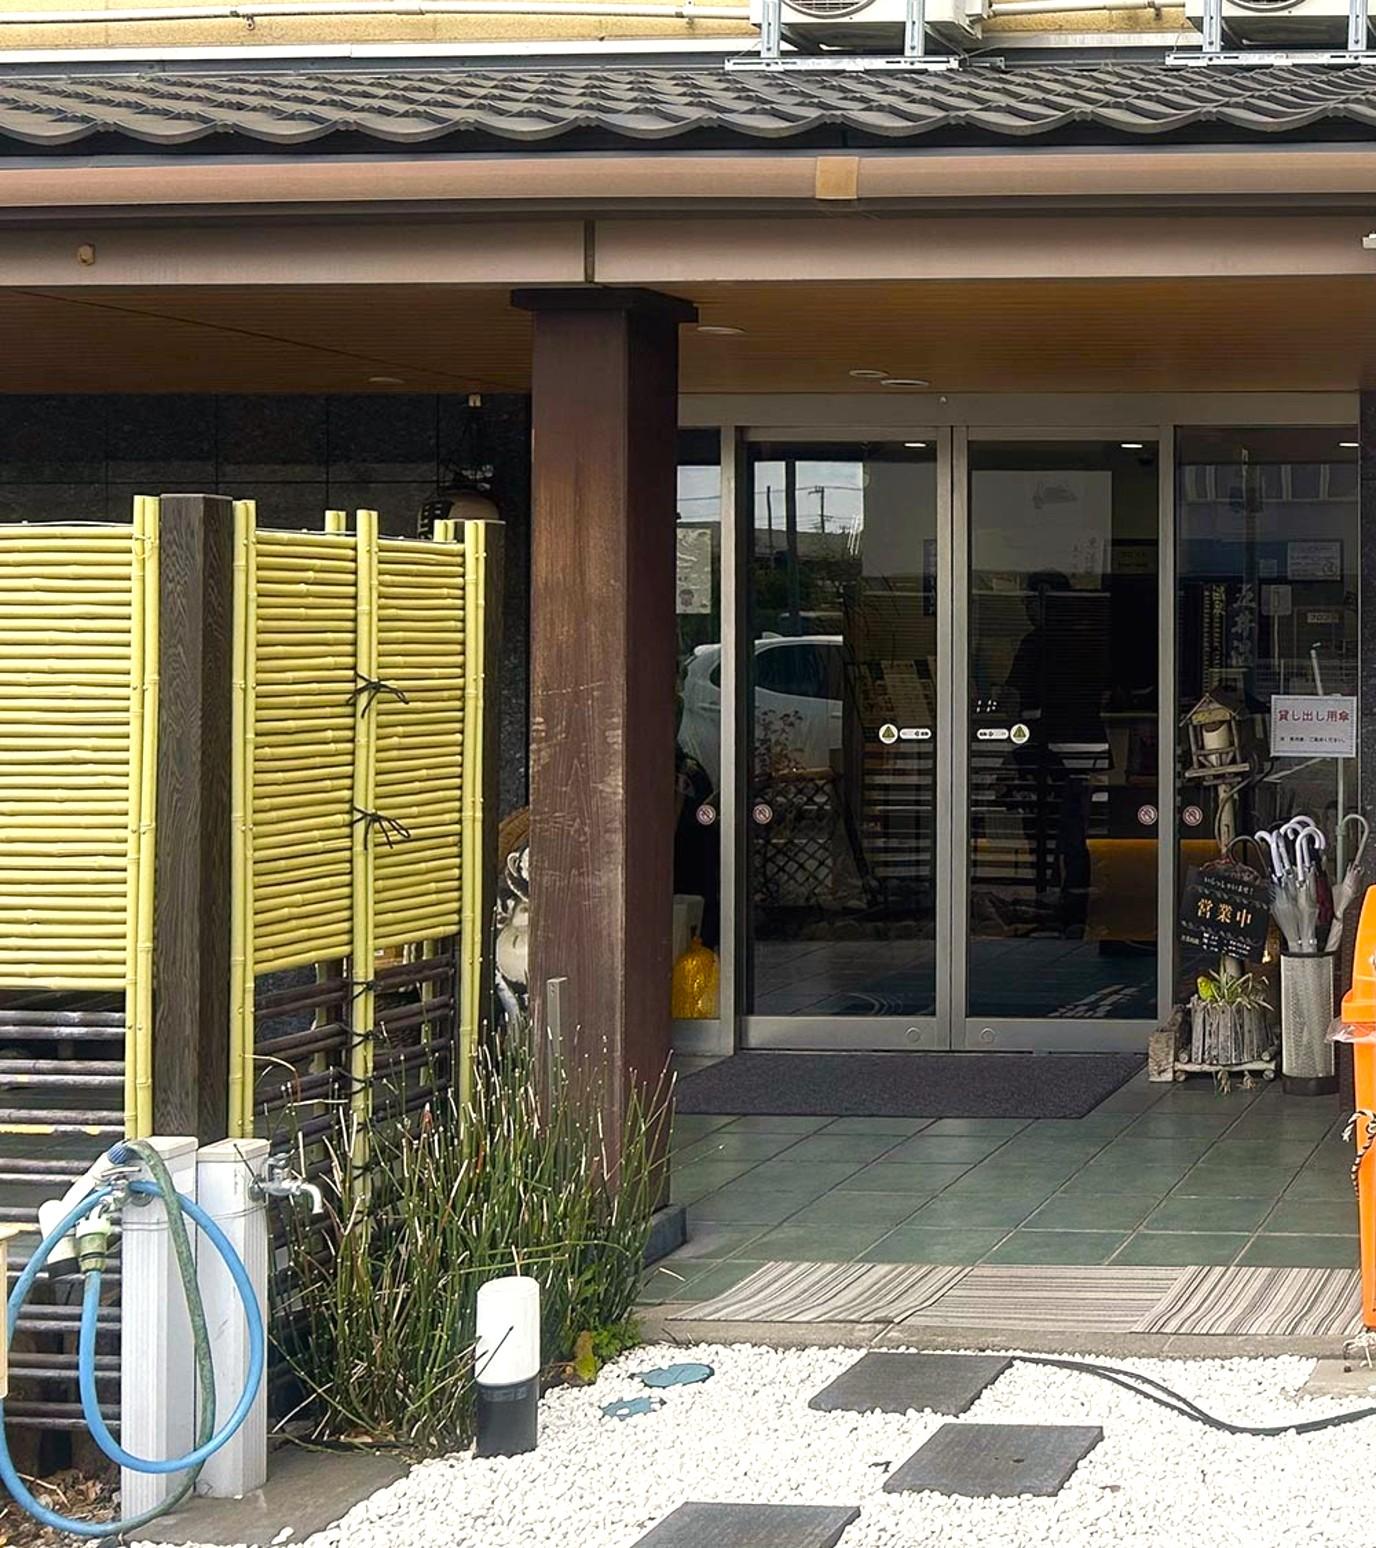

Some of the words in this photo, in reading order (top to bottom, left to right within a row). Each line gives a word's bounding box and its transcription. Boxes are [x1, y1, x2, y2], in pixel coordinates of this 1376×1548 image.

[1278, 710, 1350, 722] 貸し出し用傘
[1197, 897, 1253, 928] 営業中
